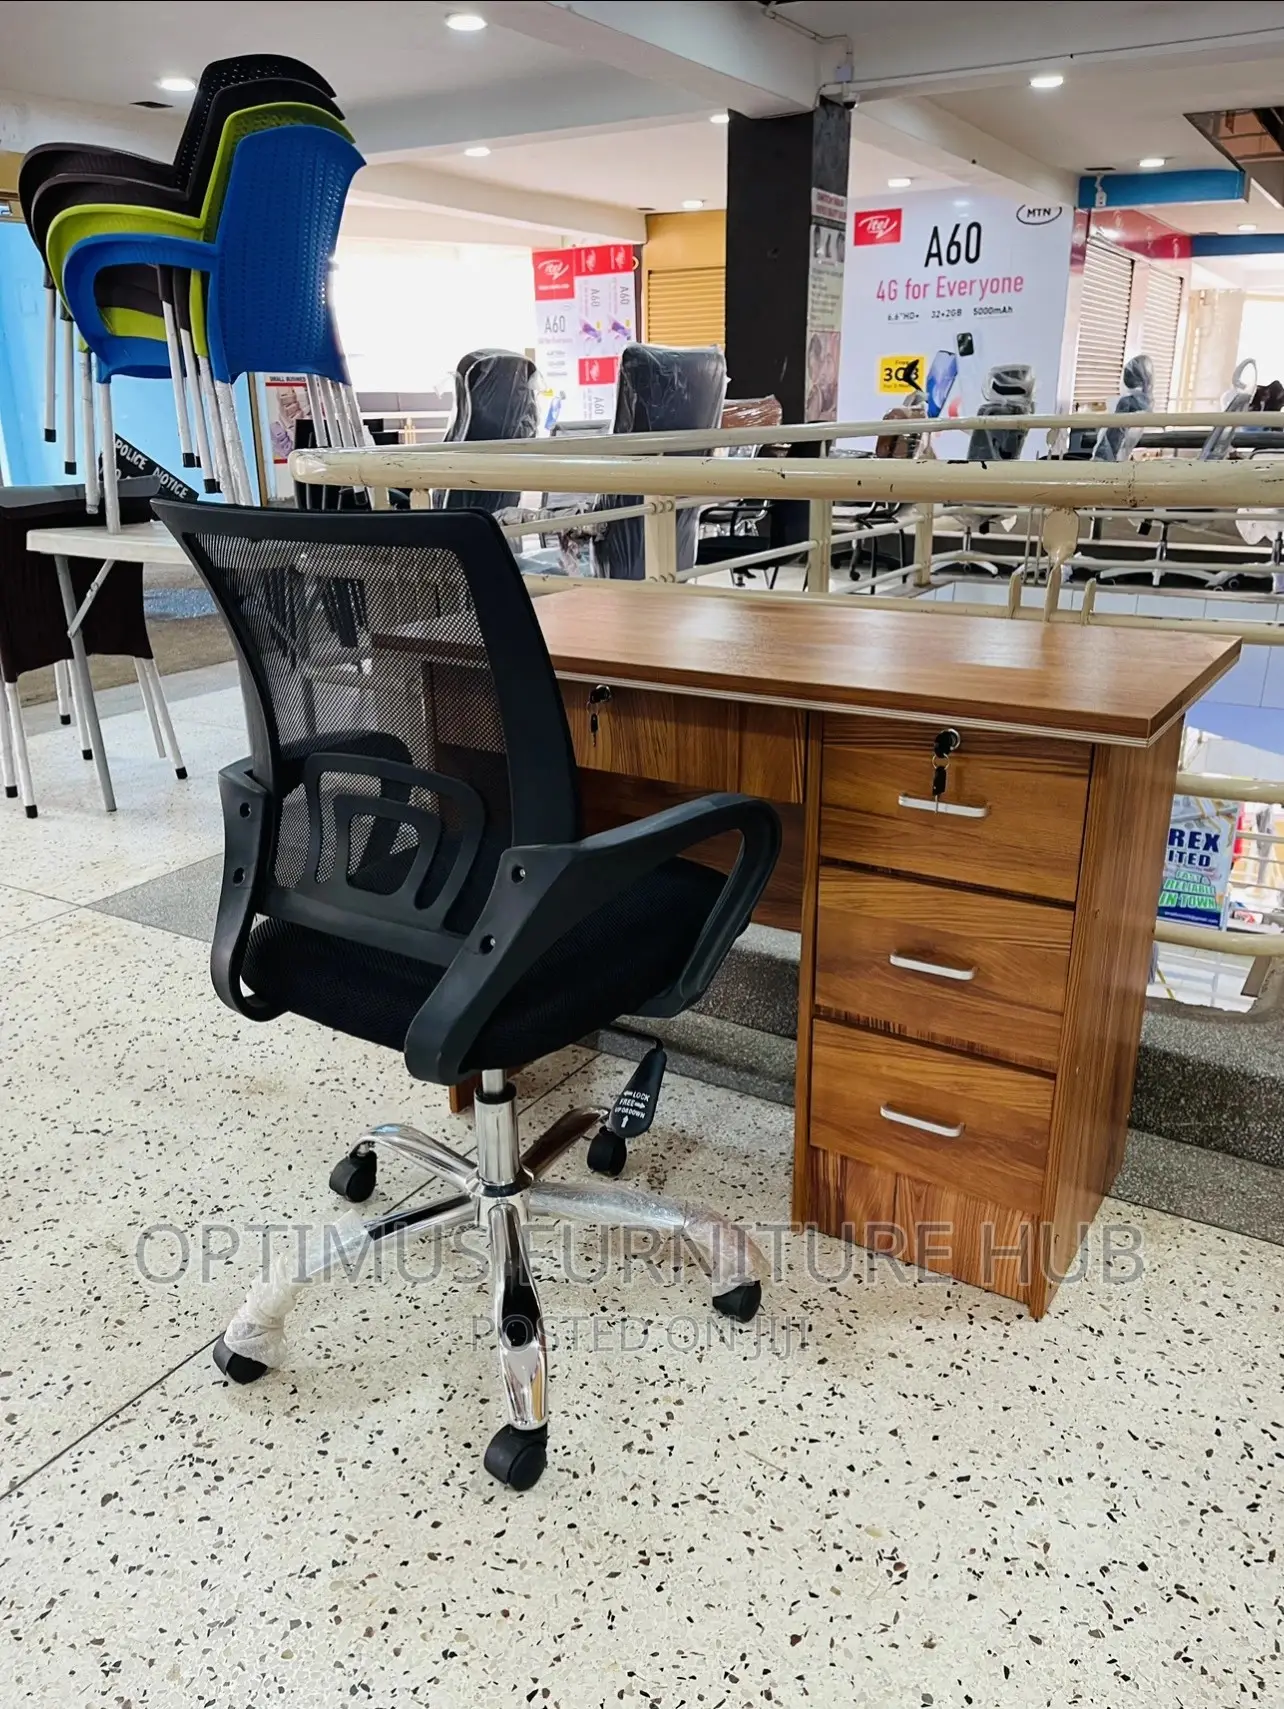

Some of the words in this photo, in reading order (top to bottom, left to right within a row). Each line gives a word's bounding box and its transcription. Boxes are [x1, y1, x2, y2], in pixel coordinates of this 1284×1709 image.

[1027, 207, 1052, 218] MTN
[924, 221, 982, 268] A60
[876, 279, 899, 301] 4G
[905, 278, 930, 300] for
[936, 275, 1024, 301] Everyone
[973, 305, 1013, 316] 5000mAh
[544, 315, 566, 333] A60
[114, 438, 148, 471] POLICE
[152, 467, 189, 499] NOTICE
[1158, 891, 1179, 907] IN
[1179, 893, 1217, 909] TOWN
[619, 1098, 636, 1107] FREE
[632, 1091, 650, 1102] LOCK
